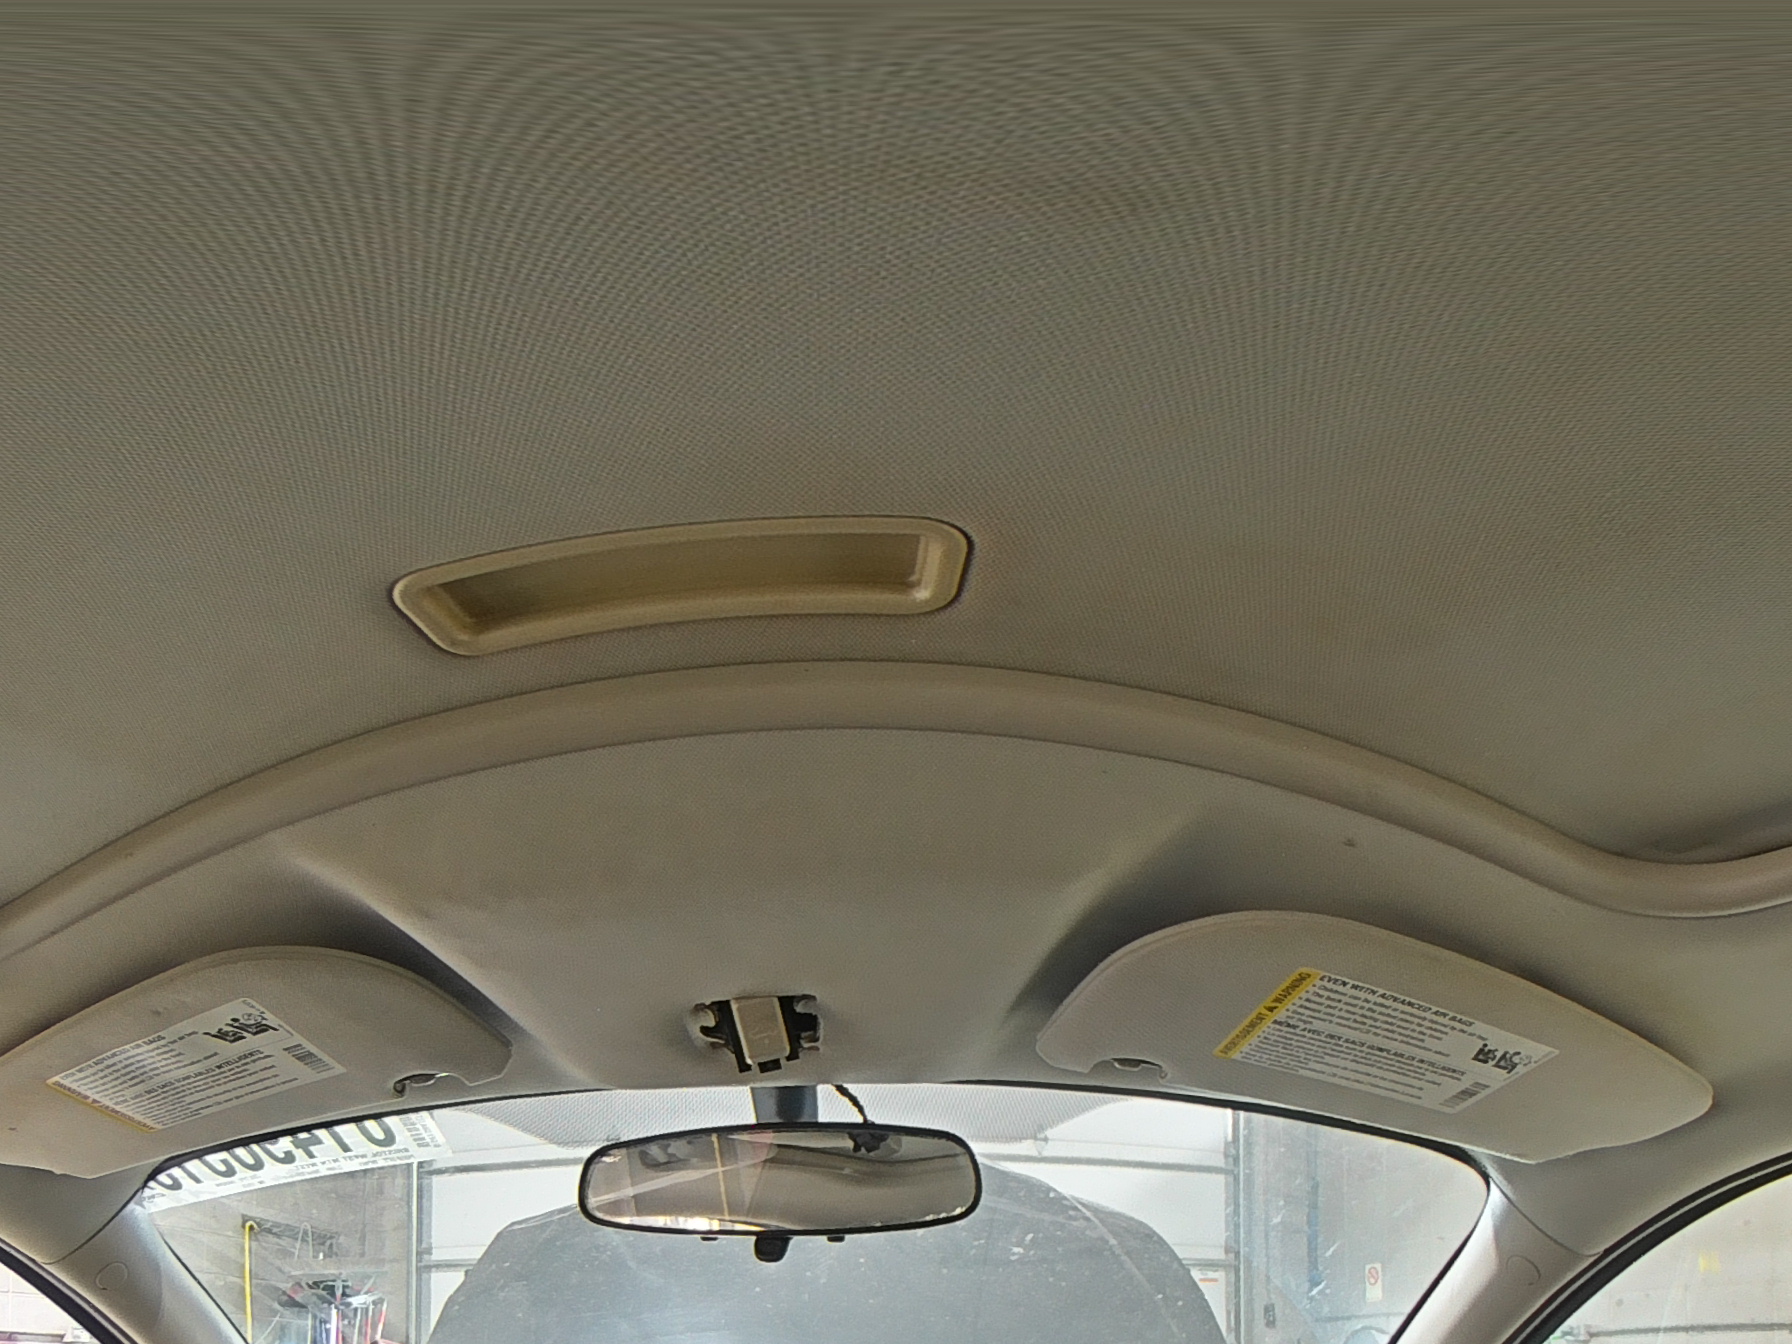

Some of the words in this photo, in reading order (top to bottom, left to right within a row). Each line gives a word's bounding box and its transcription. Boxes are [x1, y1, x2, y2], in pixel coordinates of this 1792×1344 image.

[1275, 971, 1312, 1005] WARNING
[1319, 974, 1348, 986] EVEN
[1349, 984, 1377, 995] WITH
[1378, 992, 1432, 1012] ADVANCED
[1448, 1016, 1475, 1026] BAGS
[1301, 1027, 1324, 1035] AVEC
